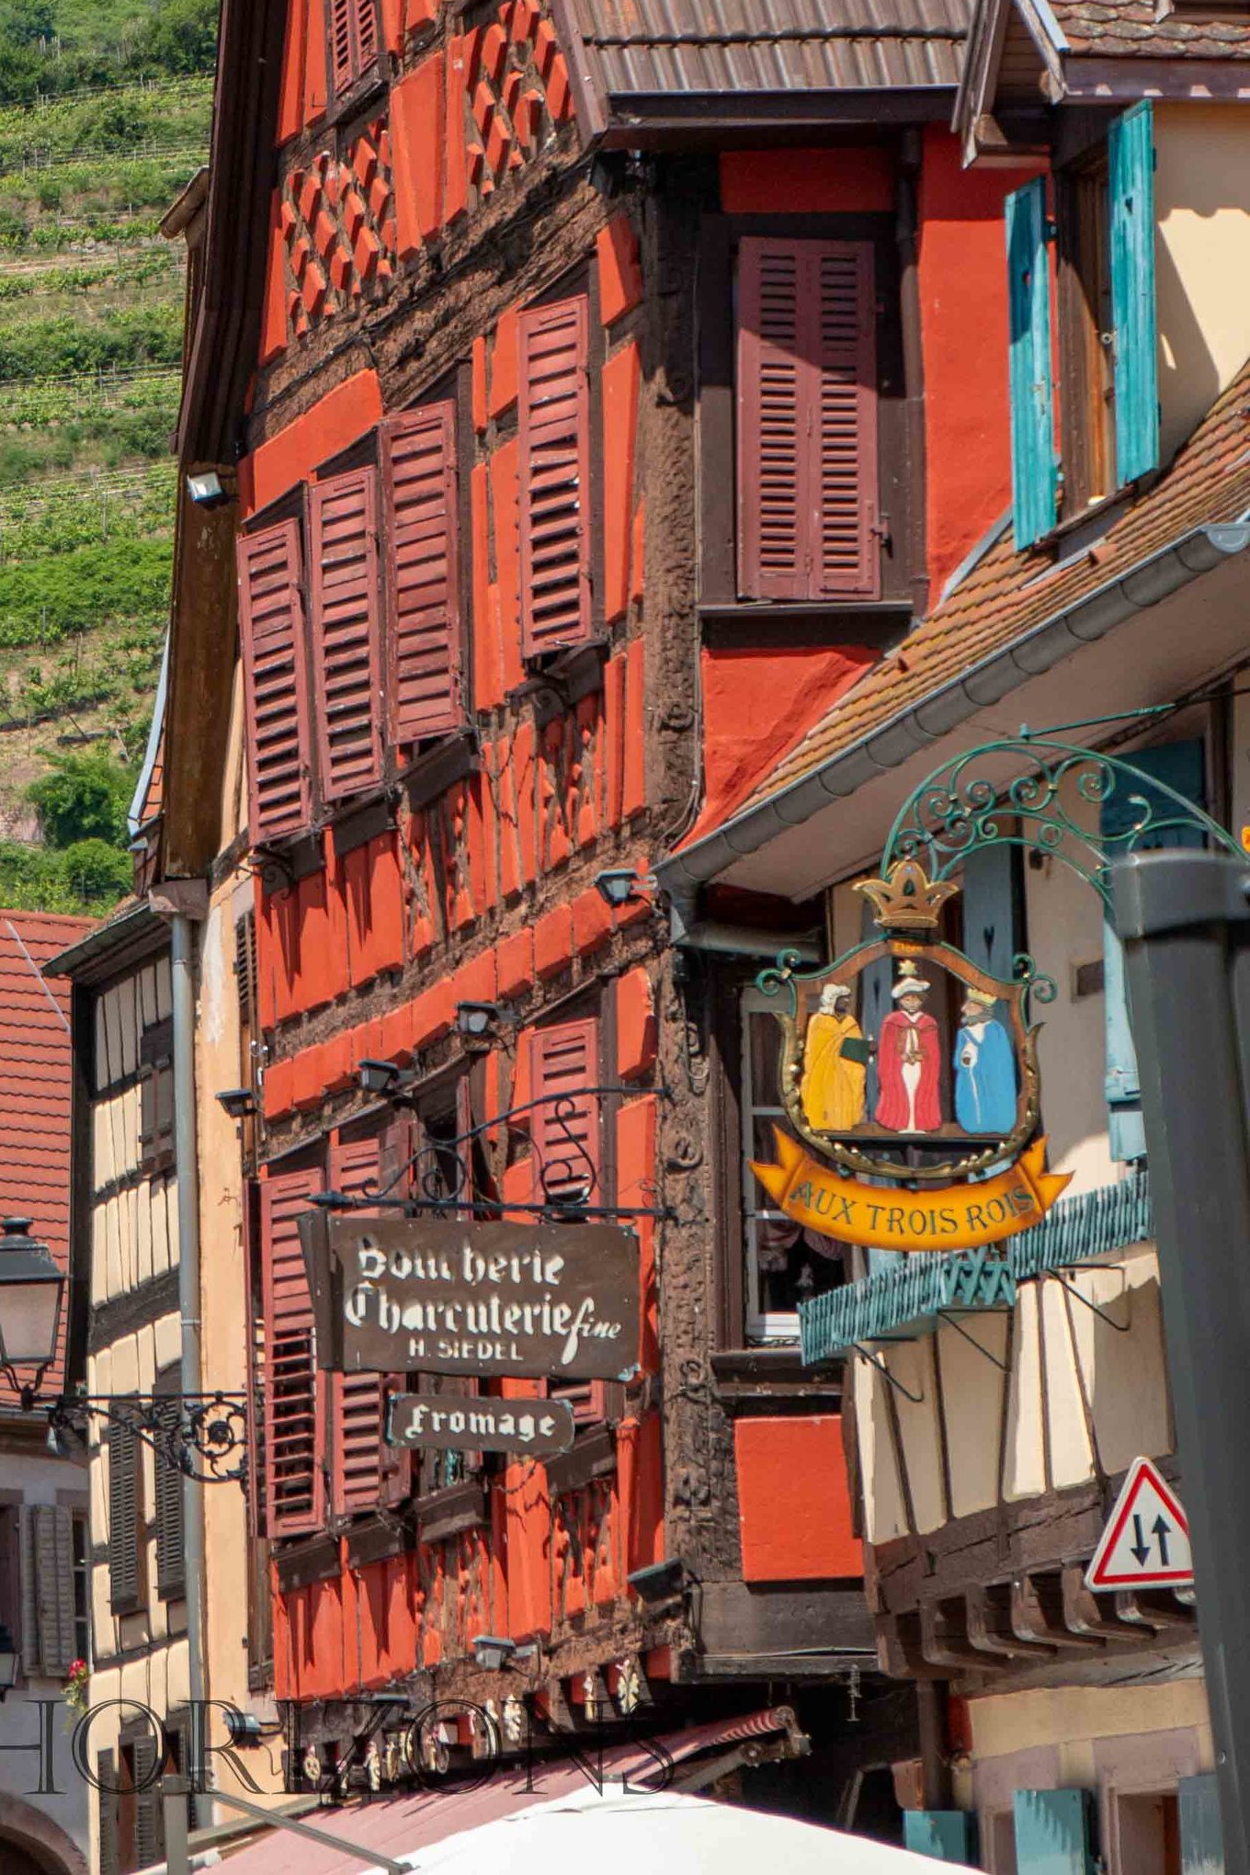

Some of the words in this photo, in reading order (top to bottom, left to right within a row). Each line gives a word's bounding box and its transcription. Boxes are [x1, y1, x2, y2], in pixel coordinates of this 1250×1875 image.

[789, 1180, 857, 1225] AUX
[867, 1203, 958, 1235] TROIS
[966, 1183, 1034, 1231] ROIS
[345, 1279, 572, 1335] Charcuterie
[561, 1296, 622, 1365] fine
[409, 1338, 432, 1357] H.
